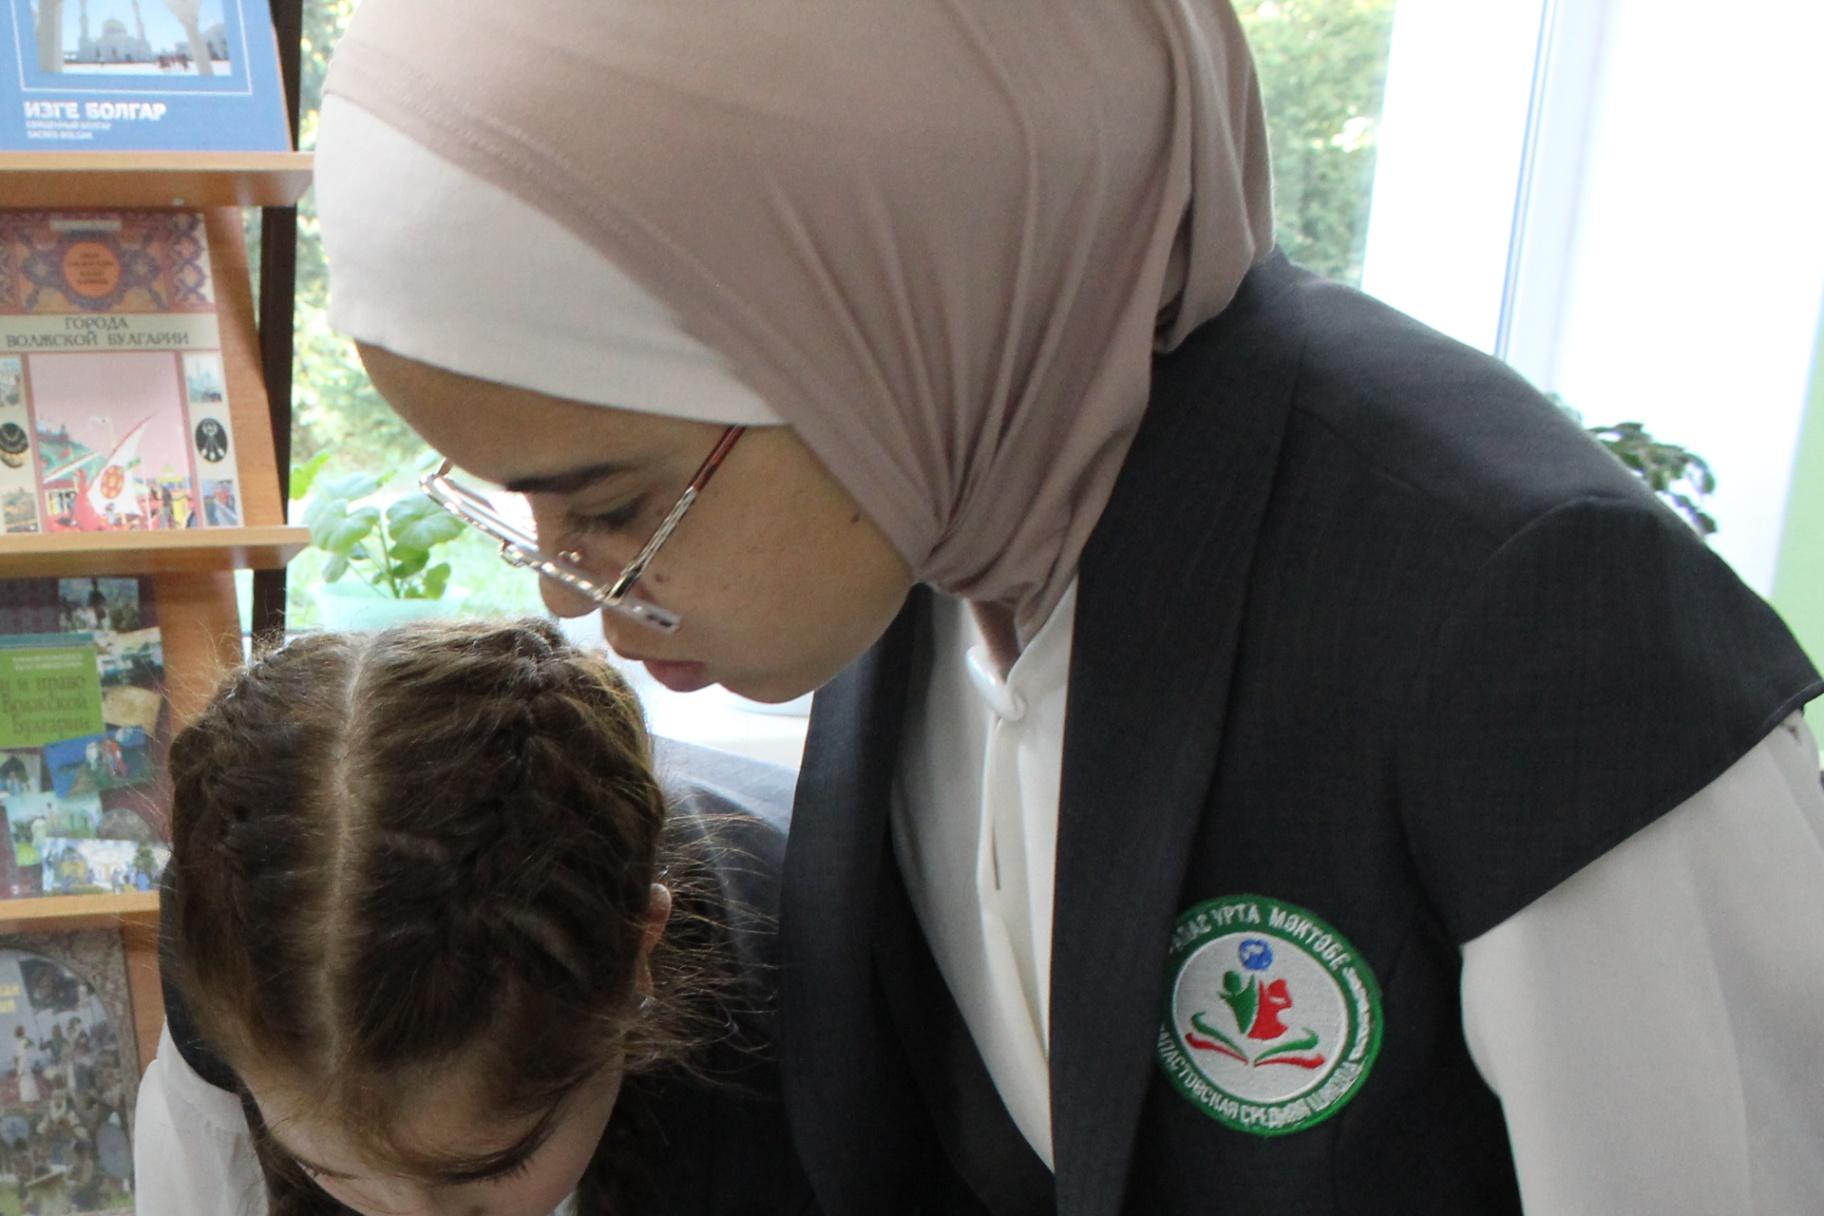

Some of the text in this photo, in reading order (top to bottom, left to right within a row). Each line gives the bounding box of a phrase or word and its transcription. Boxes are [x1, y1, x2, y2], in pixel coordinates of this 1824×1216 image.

[24, 101, 167, 120] ИЗГЕ БОЛГАР
[65, 317, 128, 330] ГОРОДА
[6, 331, 189, 347] ВОЛЖСКОЙ БУЛГАРИИ
